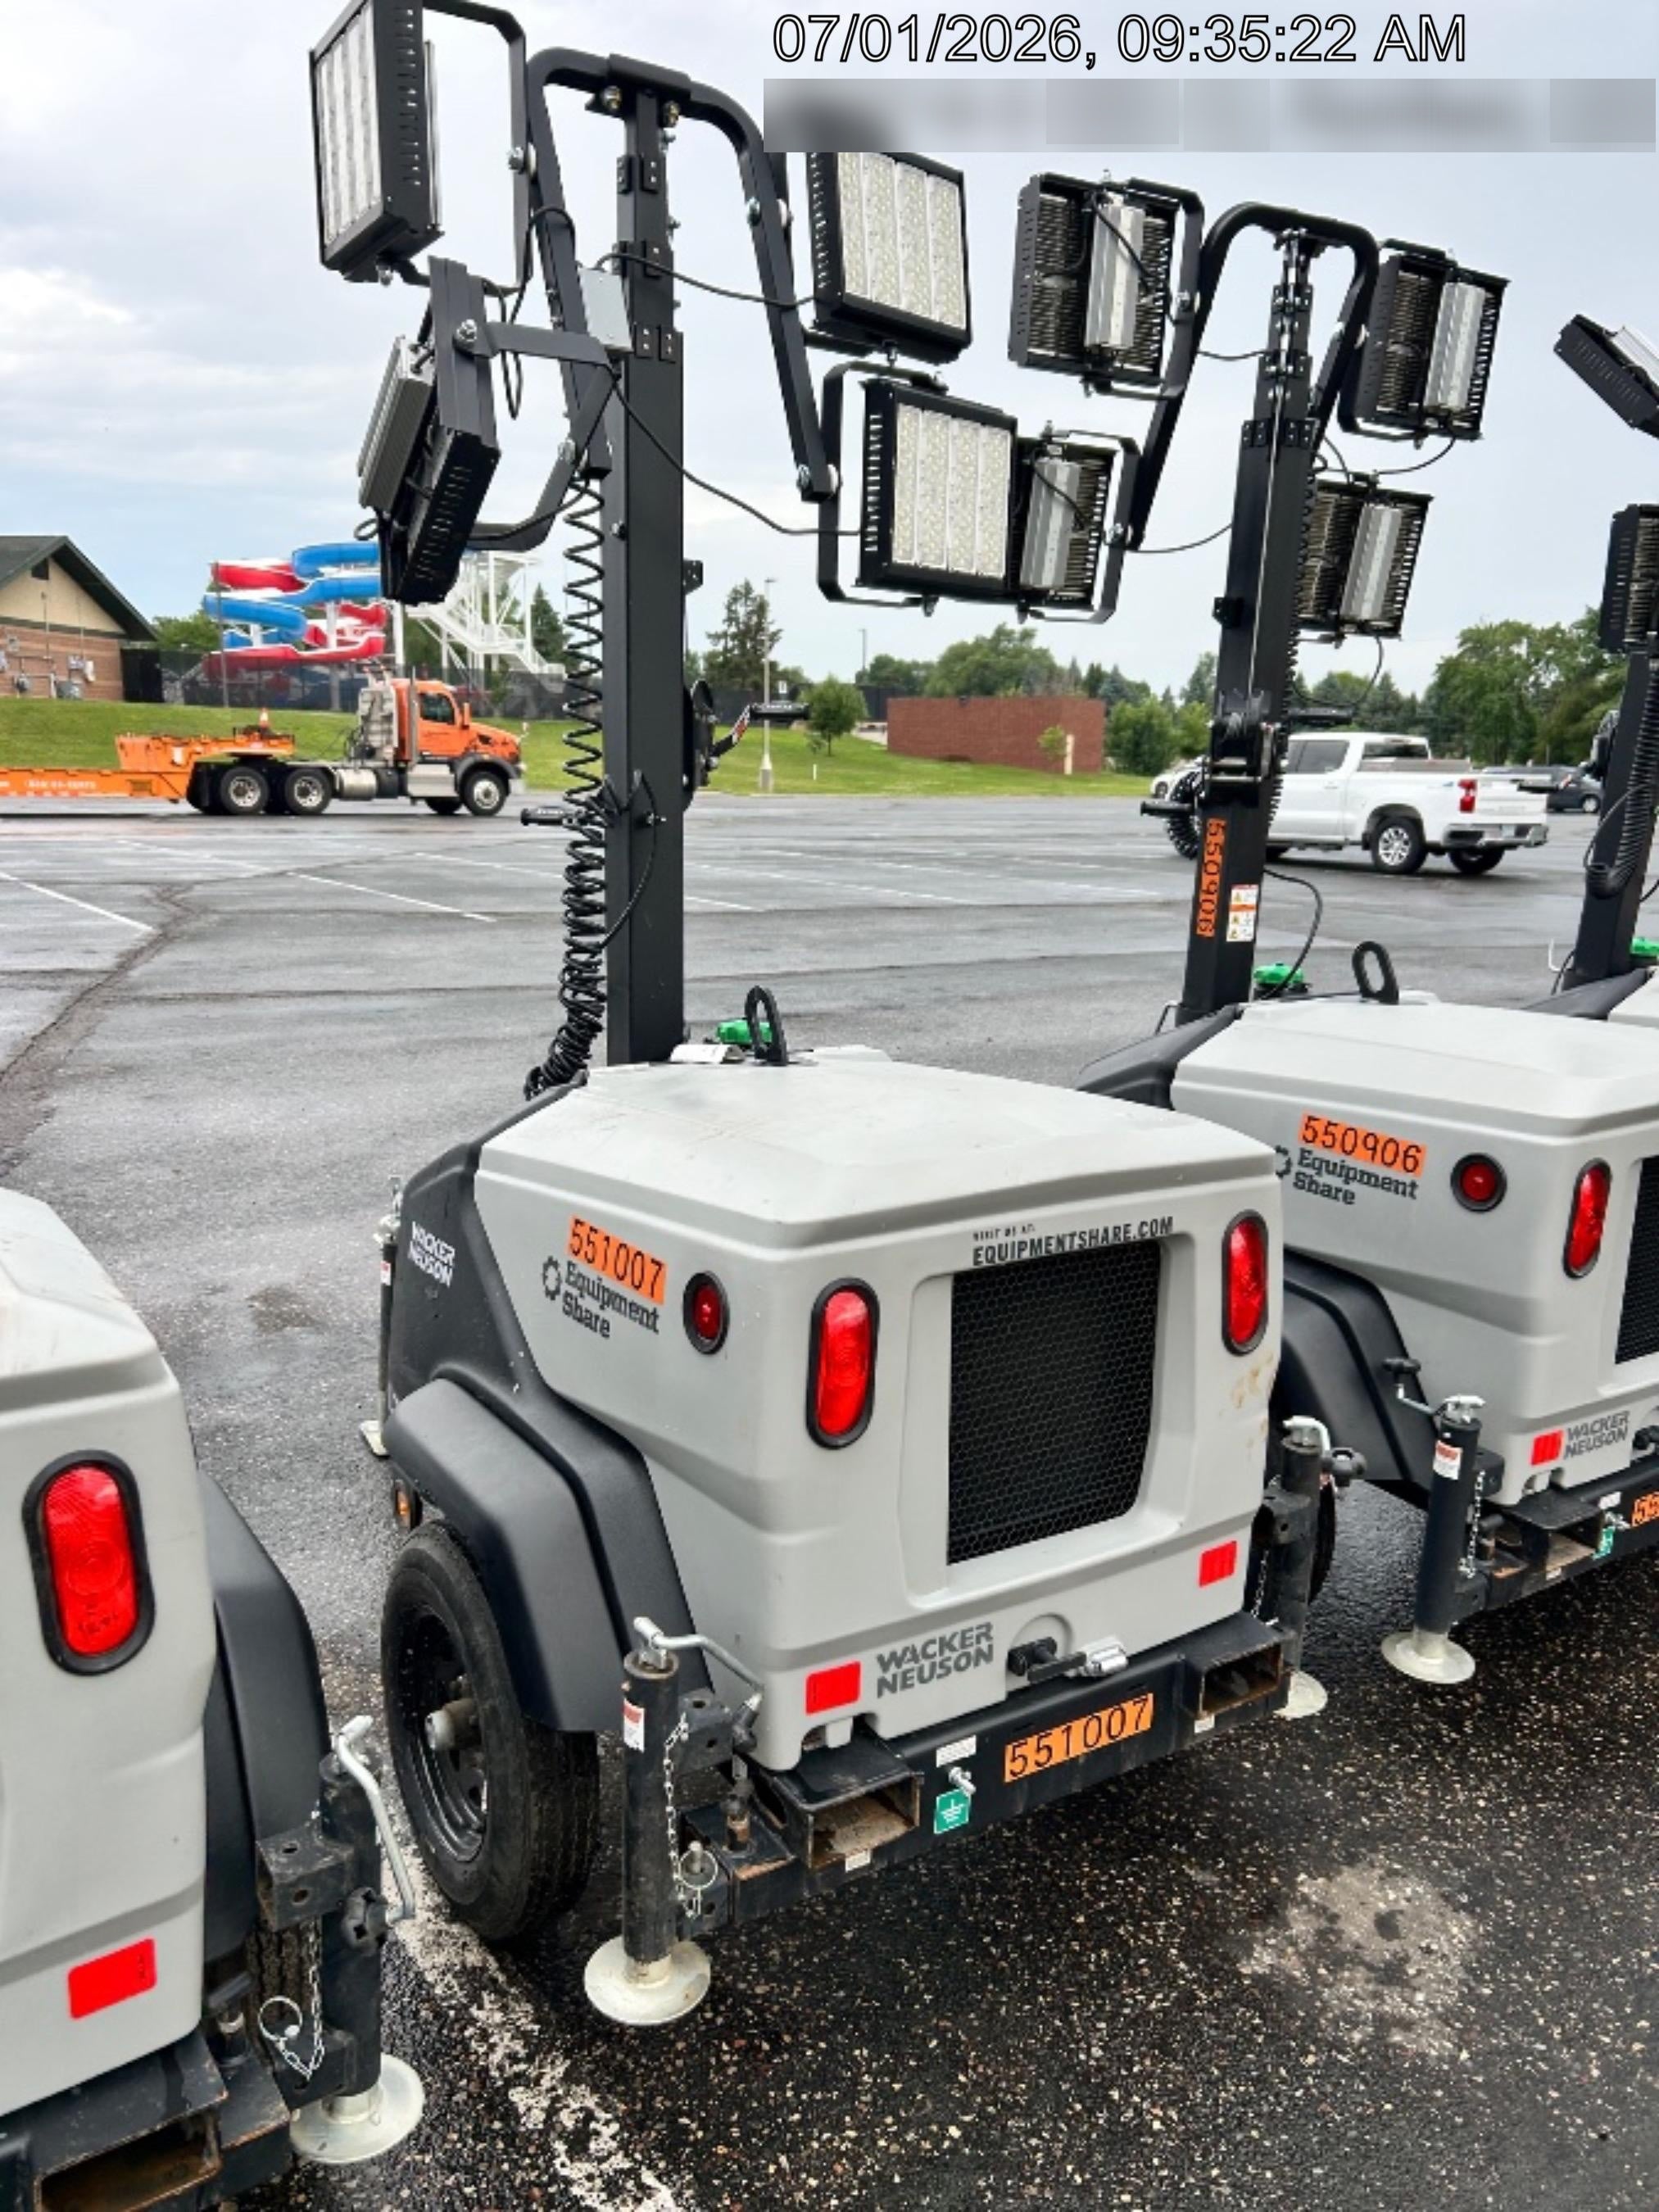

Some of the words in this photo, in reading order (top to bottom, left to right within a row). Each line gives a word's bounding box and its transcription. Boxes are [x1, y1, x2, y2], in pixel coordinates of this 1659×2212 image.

[1303, 1115, 1422, 1172] 550906
[1293, 1172, 1356, 1205] Share
[1298, 1147, 1420, 1199] Equipment
[571, 1219, 664, 1299] 551007
[973, 1217, 1172, 1265] EQUIPMENTSHARE.COM
[562, 1296, 610, 1339] Share
[565, 1261, 660, 1334] Equipment
[1563, 1426, 1628, 1459] NEUSON
[1567, 1411, 1629, 1440] WACKER
[877, 1622, 993, 1673] WACKER
[877, 1643, 993, 1698] NEUSON
[1009, 1698, 1147, 1778] 551007
